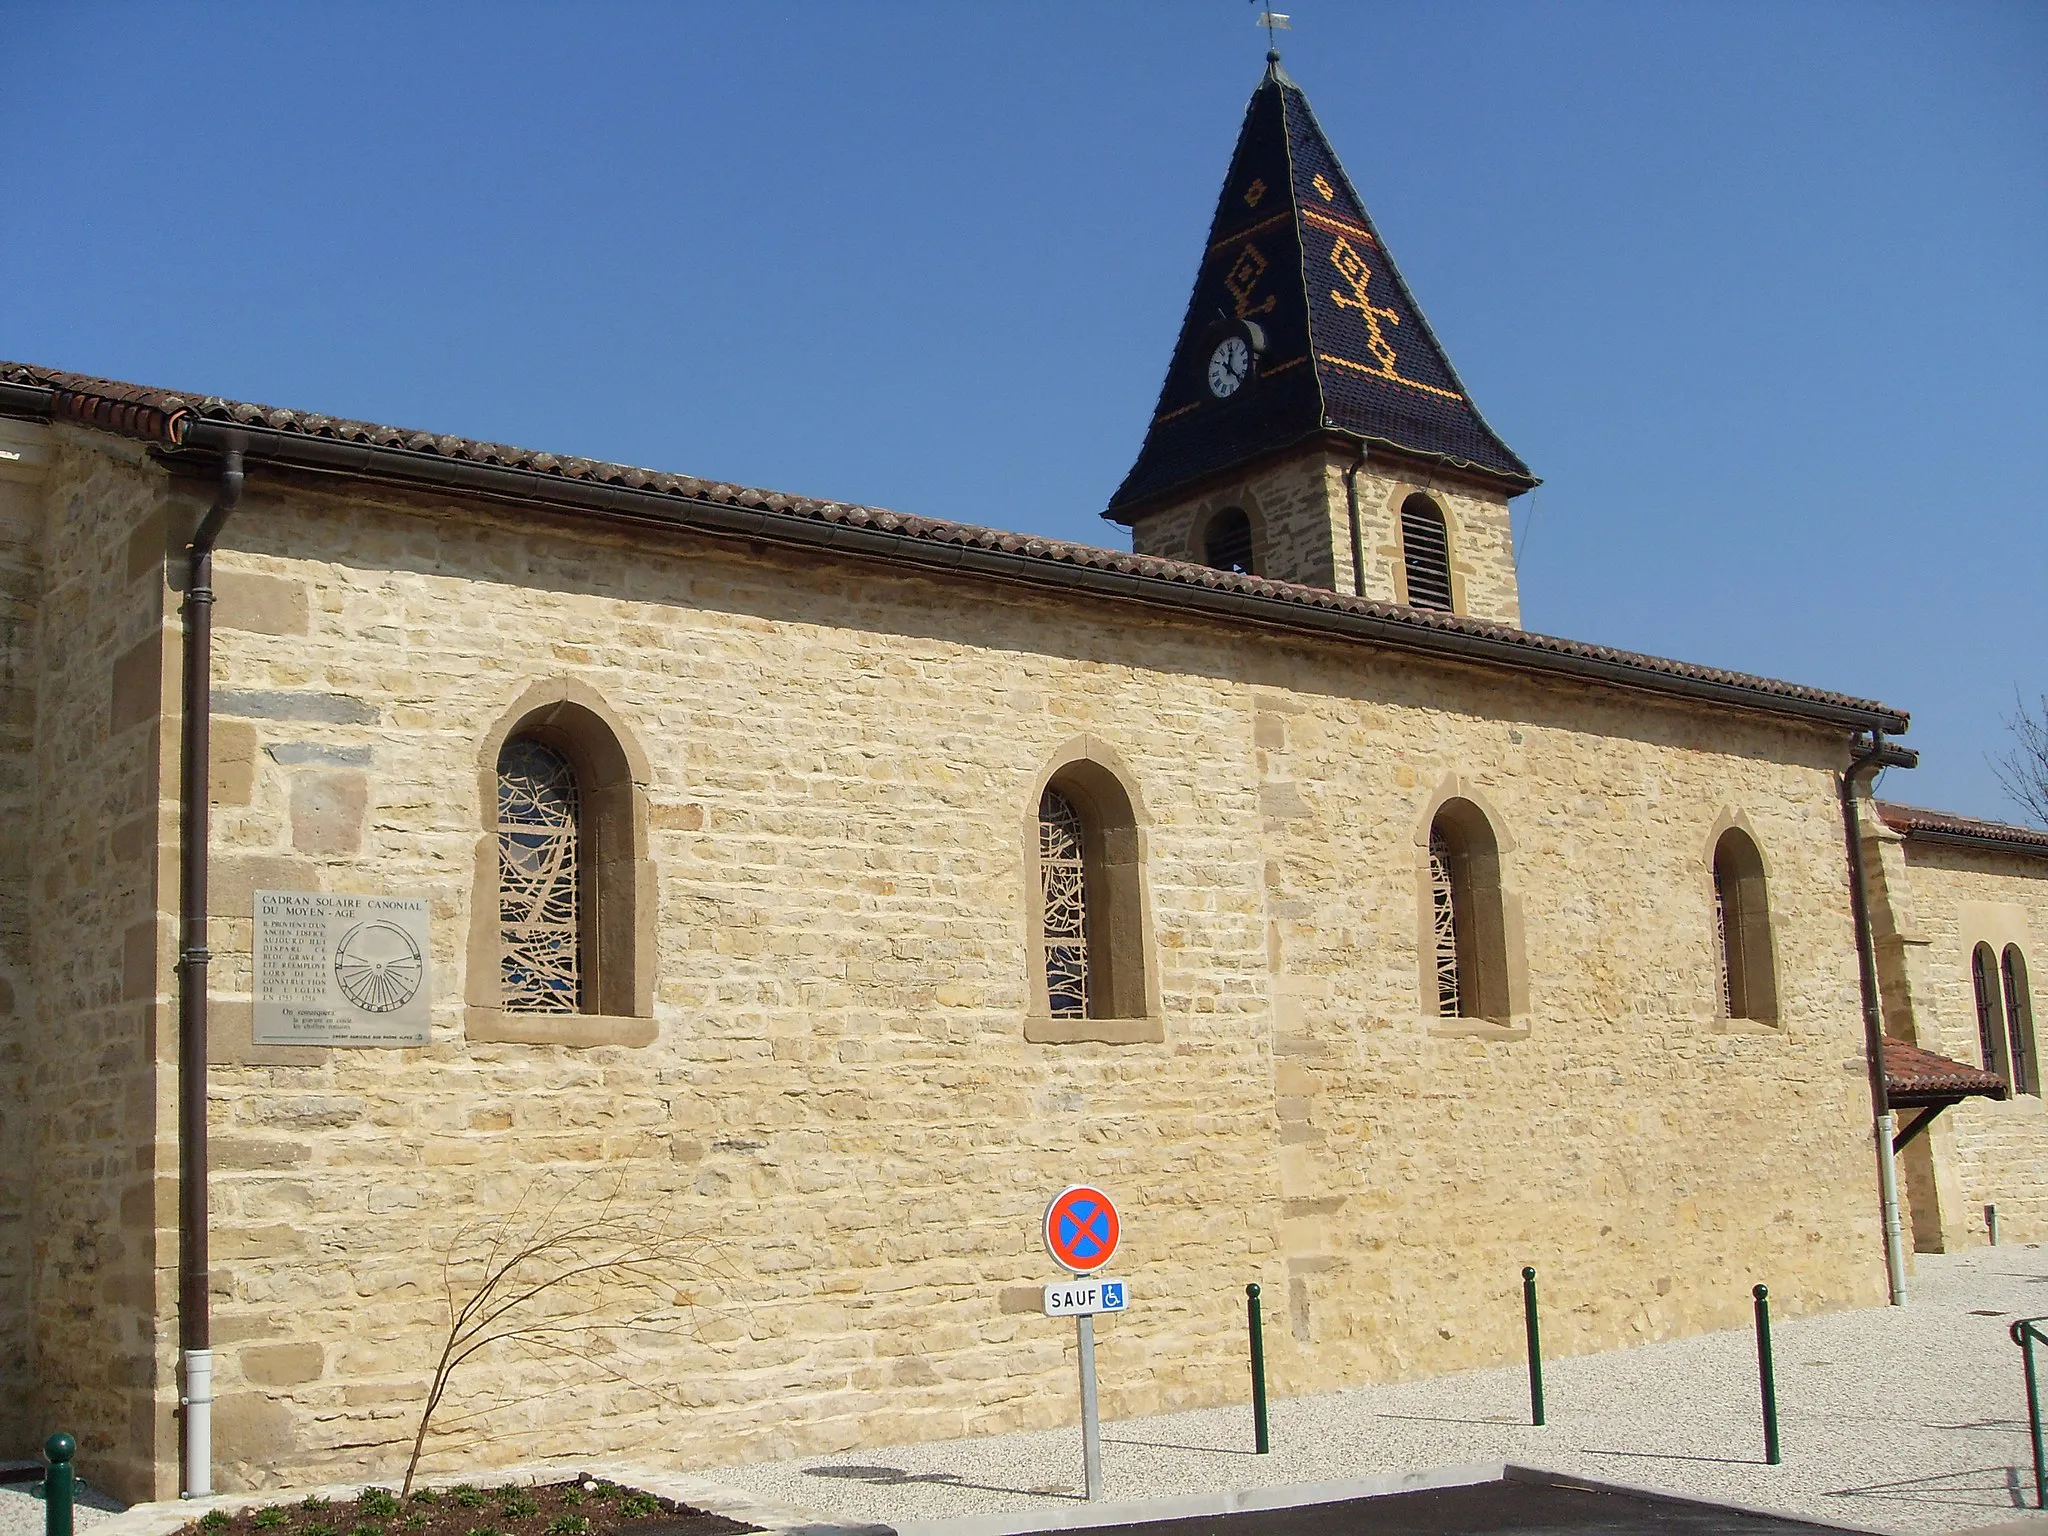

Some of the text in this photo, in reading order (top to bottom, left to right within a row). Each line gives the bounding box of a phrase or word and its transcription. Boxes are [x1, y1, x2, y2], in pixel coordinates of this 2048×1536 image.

[262, 895, 422, 911] CADRAN SOLAIRE CANONIAL
[262, 906, 279, 915] DU
[285, 907, 325, 917] MOYEN
[335, 909, 355, 918] AGE
[1051, 1289, 1097, 1308] SAUF
